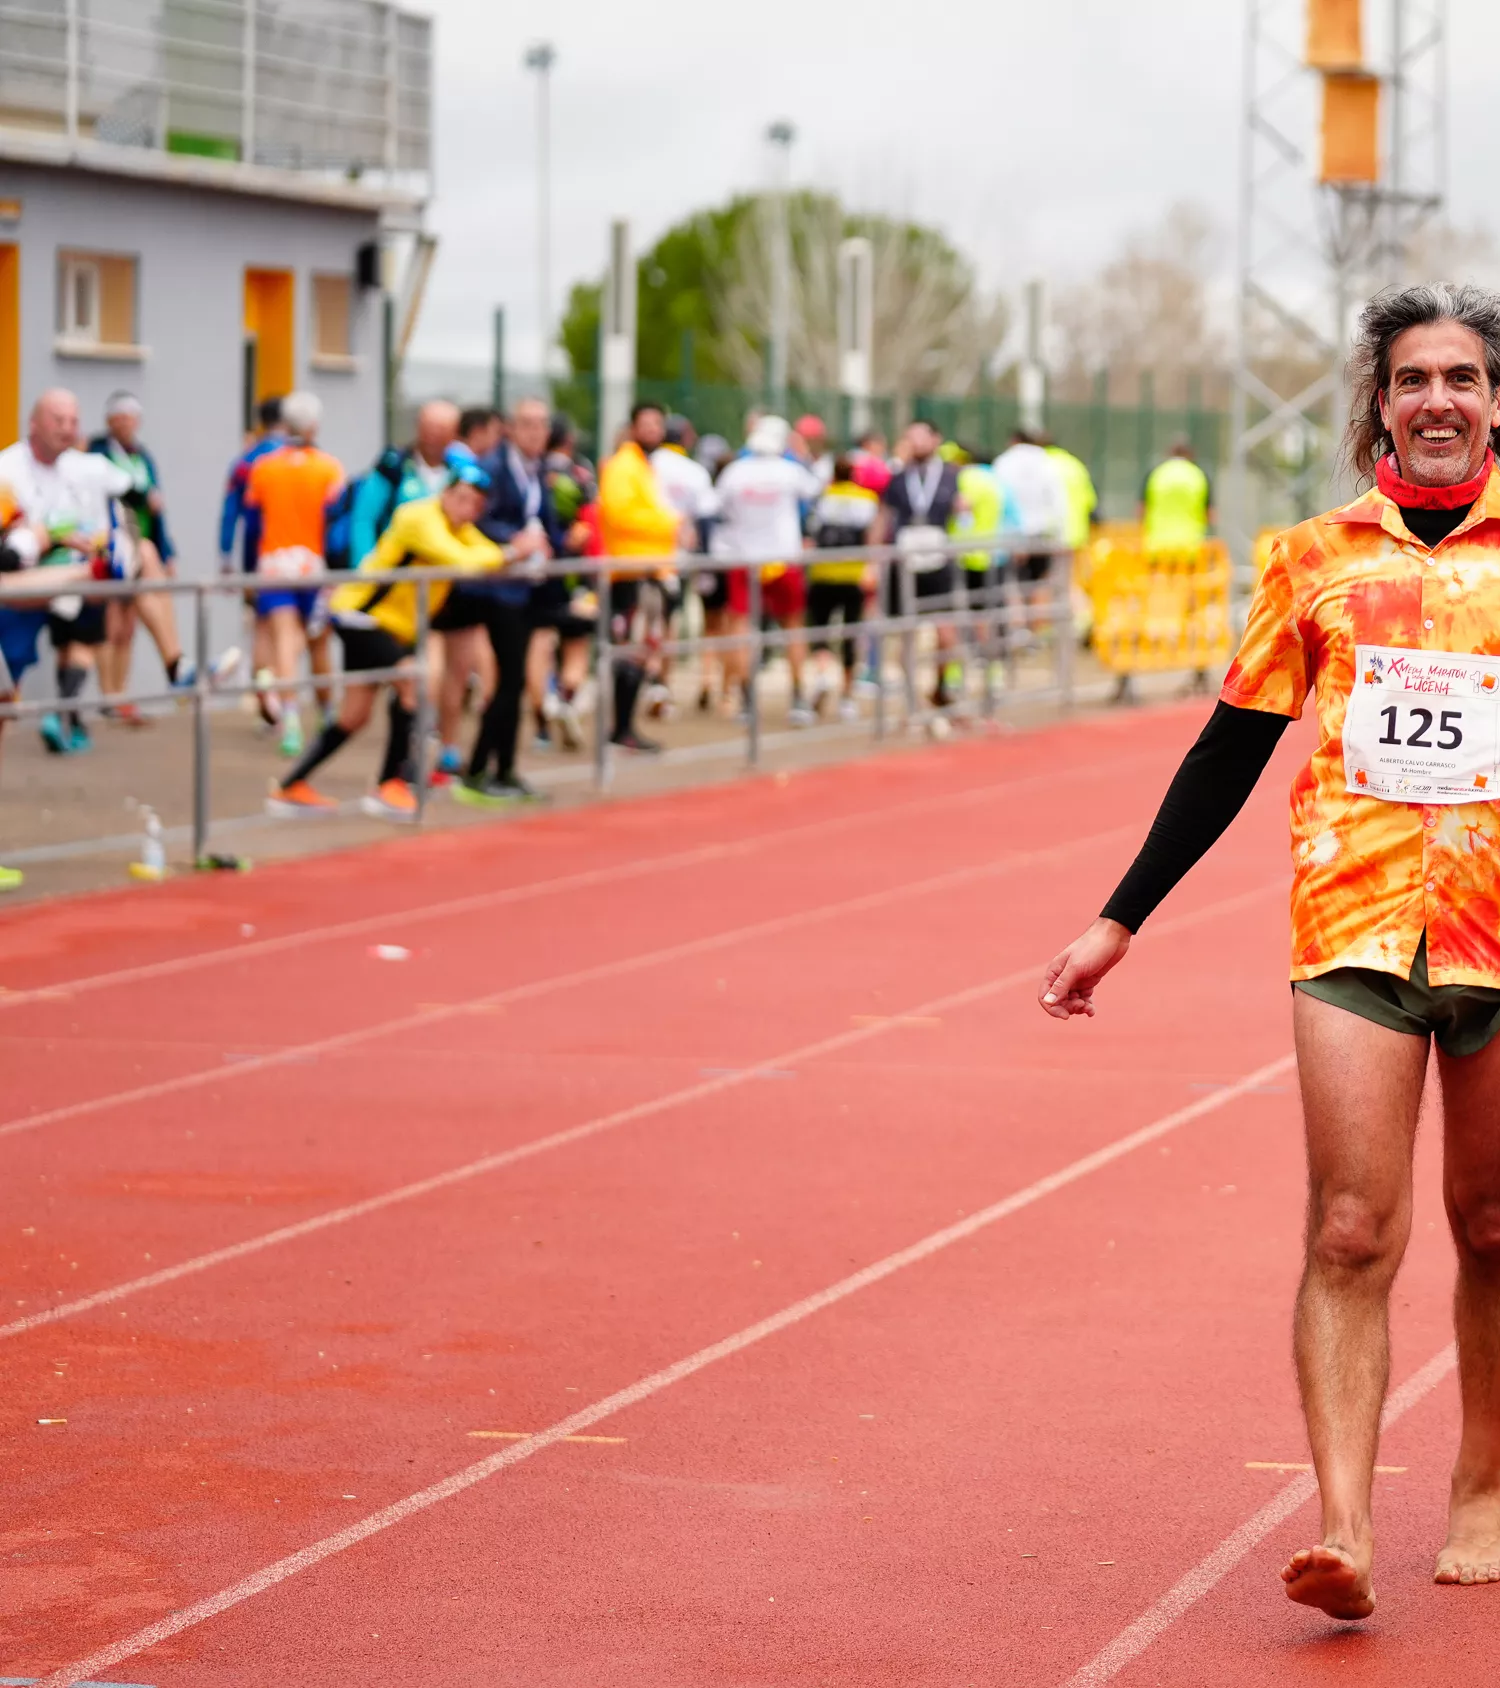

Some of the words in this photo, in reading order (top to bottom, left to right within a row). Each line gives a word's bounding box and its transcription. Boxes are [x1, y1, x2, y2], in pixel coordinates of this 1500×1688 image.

[1404, 676, 1454, 695] LUCENA
[1379, 705, 1463, 750] 125
[1379, 757, 1404, 765] ALBERTO
[1405, 759, 1425, 767] CALVO
[1426, 761, 1456, 769] CARRASCO
